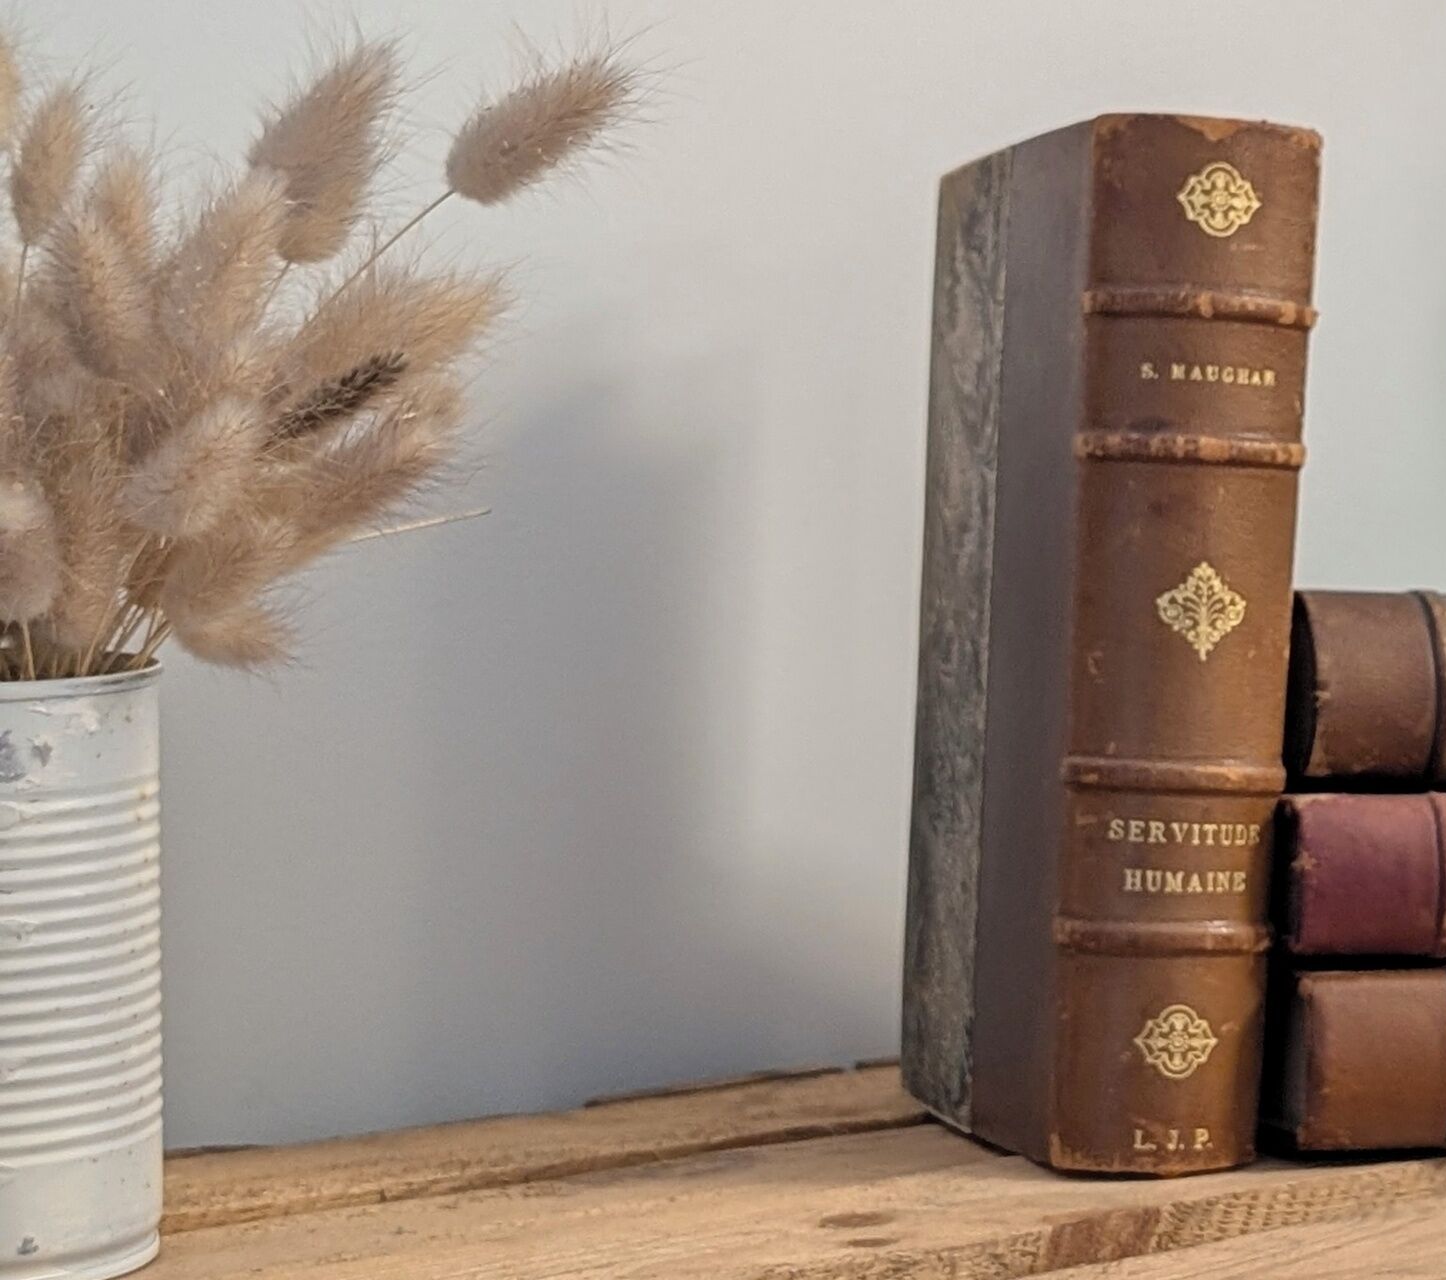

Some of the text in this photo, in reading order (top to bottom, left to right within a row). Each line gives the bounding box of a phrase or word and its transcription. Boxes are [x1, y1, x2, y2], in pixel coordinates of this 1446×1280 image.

[1140, 362, 1159, 380] S.
[1107, 818, 1261, 847] SERVITUDE
[1123, 868, 1247, 894] HUMAINE
